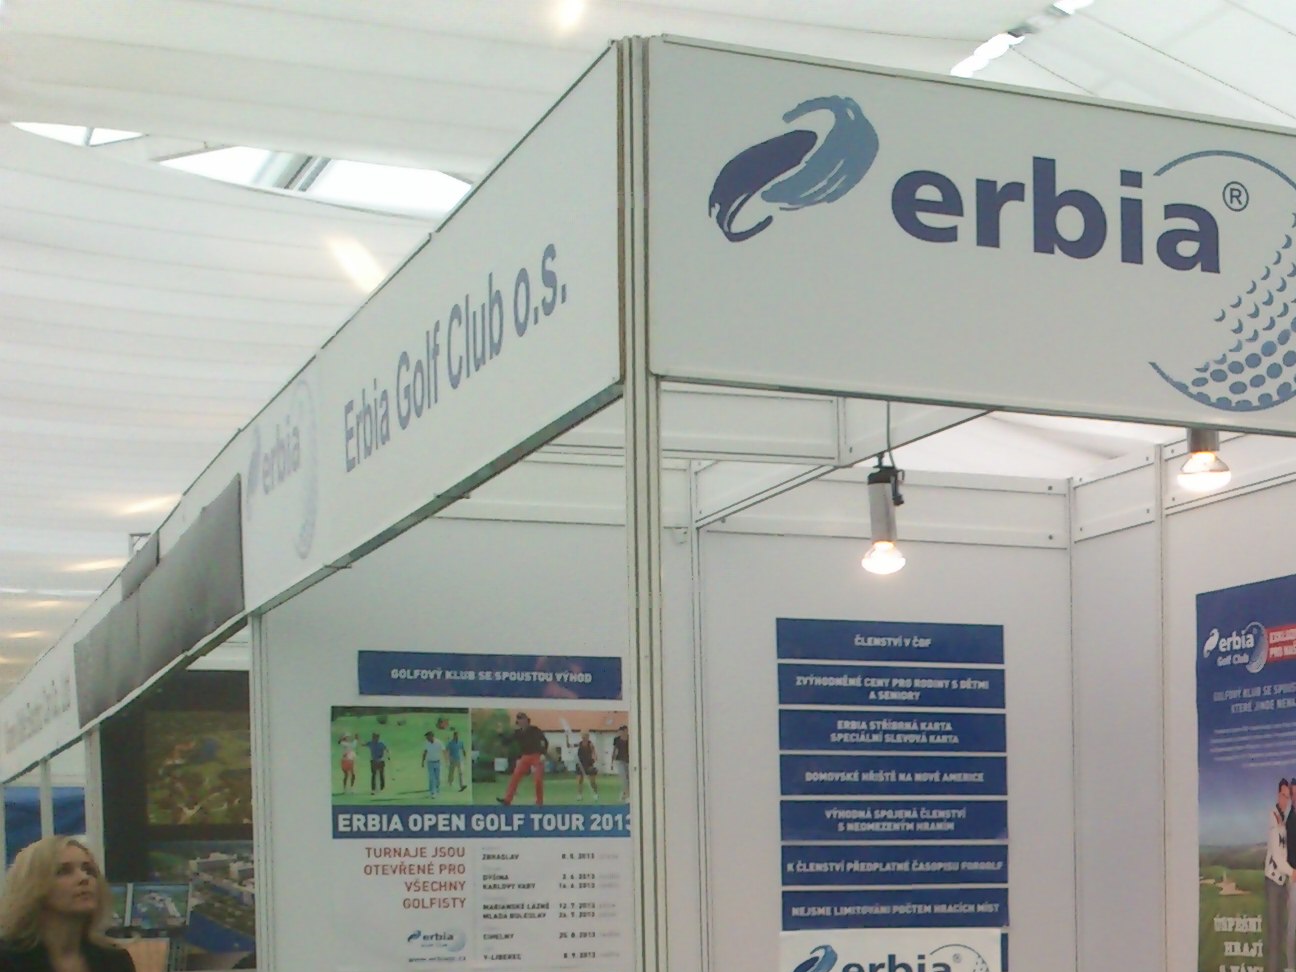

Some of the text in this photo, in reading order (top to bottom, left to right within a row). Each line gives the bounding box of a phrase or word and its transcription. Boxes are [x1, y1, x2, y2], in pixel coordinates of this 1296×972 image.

[891, 156, 1220, 275] erbia
[344, 244, 568, 473] Erbia Golf Club o.s.
[263, 414, 300, 495] erbia
[1219, 631, 1254, 652] erbia
[1217, 654, 1249, 667] Golf Club
[391, 666, 444, 680] GOLFOVÝ
[445, 669, 475, 681] KLUB
[478, 669, 492, 681] SE
[494, 670, 553, 682] SPOUSTOU
[338, 813, 404, 832] ERBIA
[408, 813, 466, 832] OPEN
[471, 814, 525, 832] GOLF
[530, 813, 584, 831] TOUR
[365, 846, 466, 859] TURNAJE JSOU
[363, 861, 466, 876] OTEVŘENÉ PRO
[405, 878, 466, 892] VŠECHNY
[403, 898, 466, 910] GOLFISTY
[422, 931, 454, 941] erbia
[1224, 941, 1264, 957] HRAJÍ
